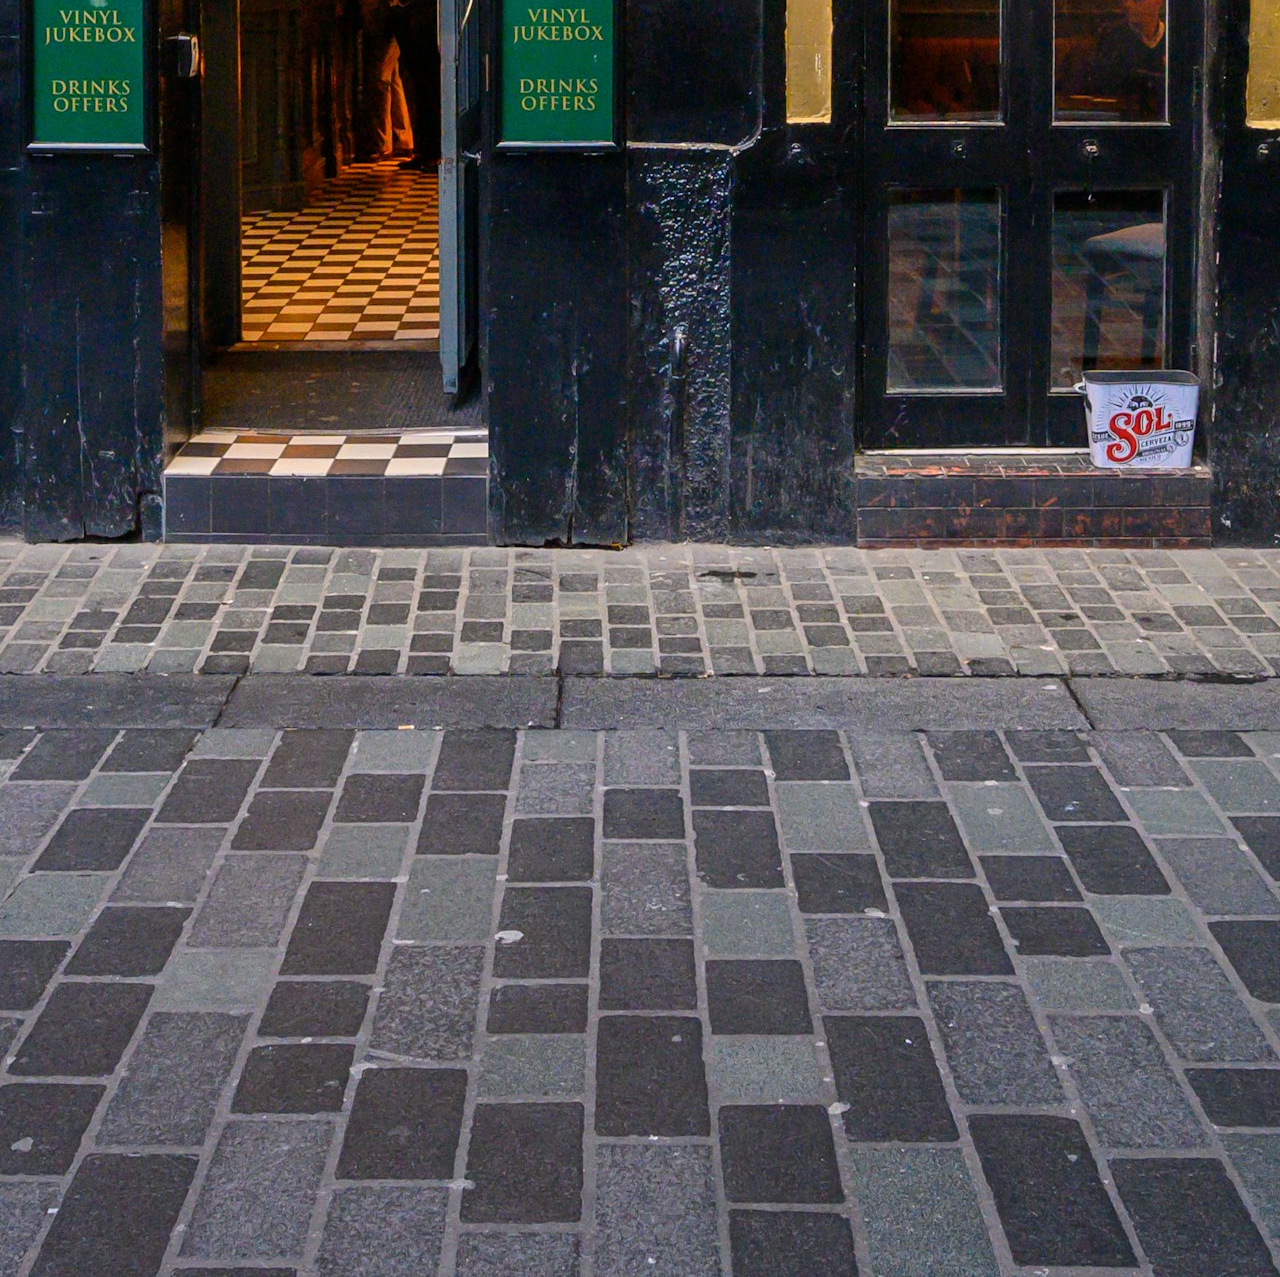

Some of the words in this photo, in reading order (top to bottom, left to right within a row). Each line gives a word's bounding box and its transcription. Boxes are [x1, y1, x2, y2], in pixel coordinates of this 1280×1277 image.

[59, 10, 122, 25] VINYL
[528, 9, 590, 24] VINYL
[45, 27, 136, 45] JUKEBOX
[513, 26, 604, 44] JUKEBOX
[51, 80, 131, 95] DRINKS
[519, 79, 599, 94] DRINKS
[53, 97, 129, 113] OFFERS
[521, 96, 596, 112] OFFERS
[1140, 435, 1173, 448] CERVEZA
